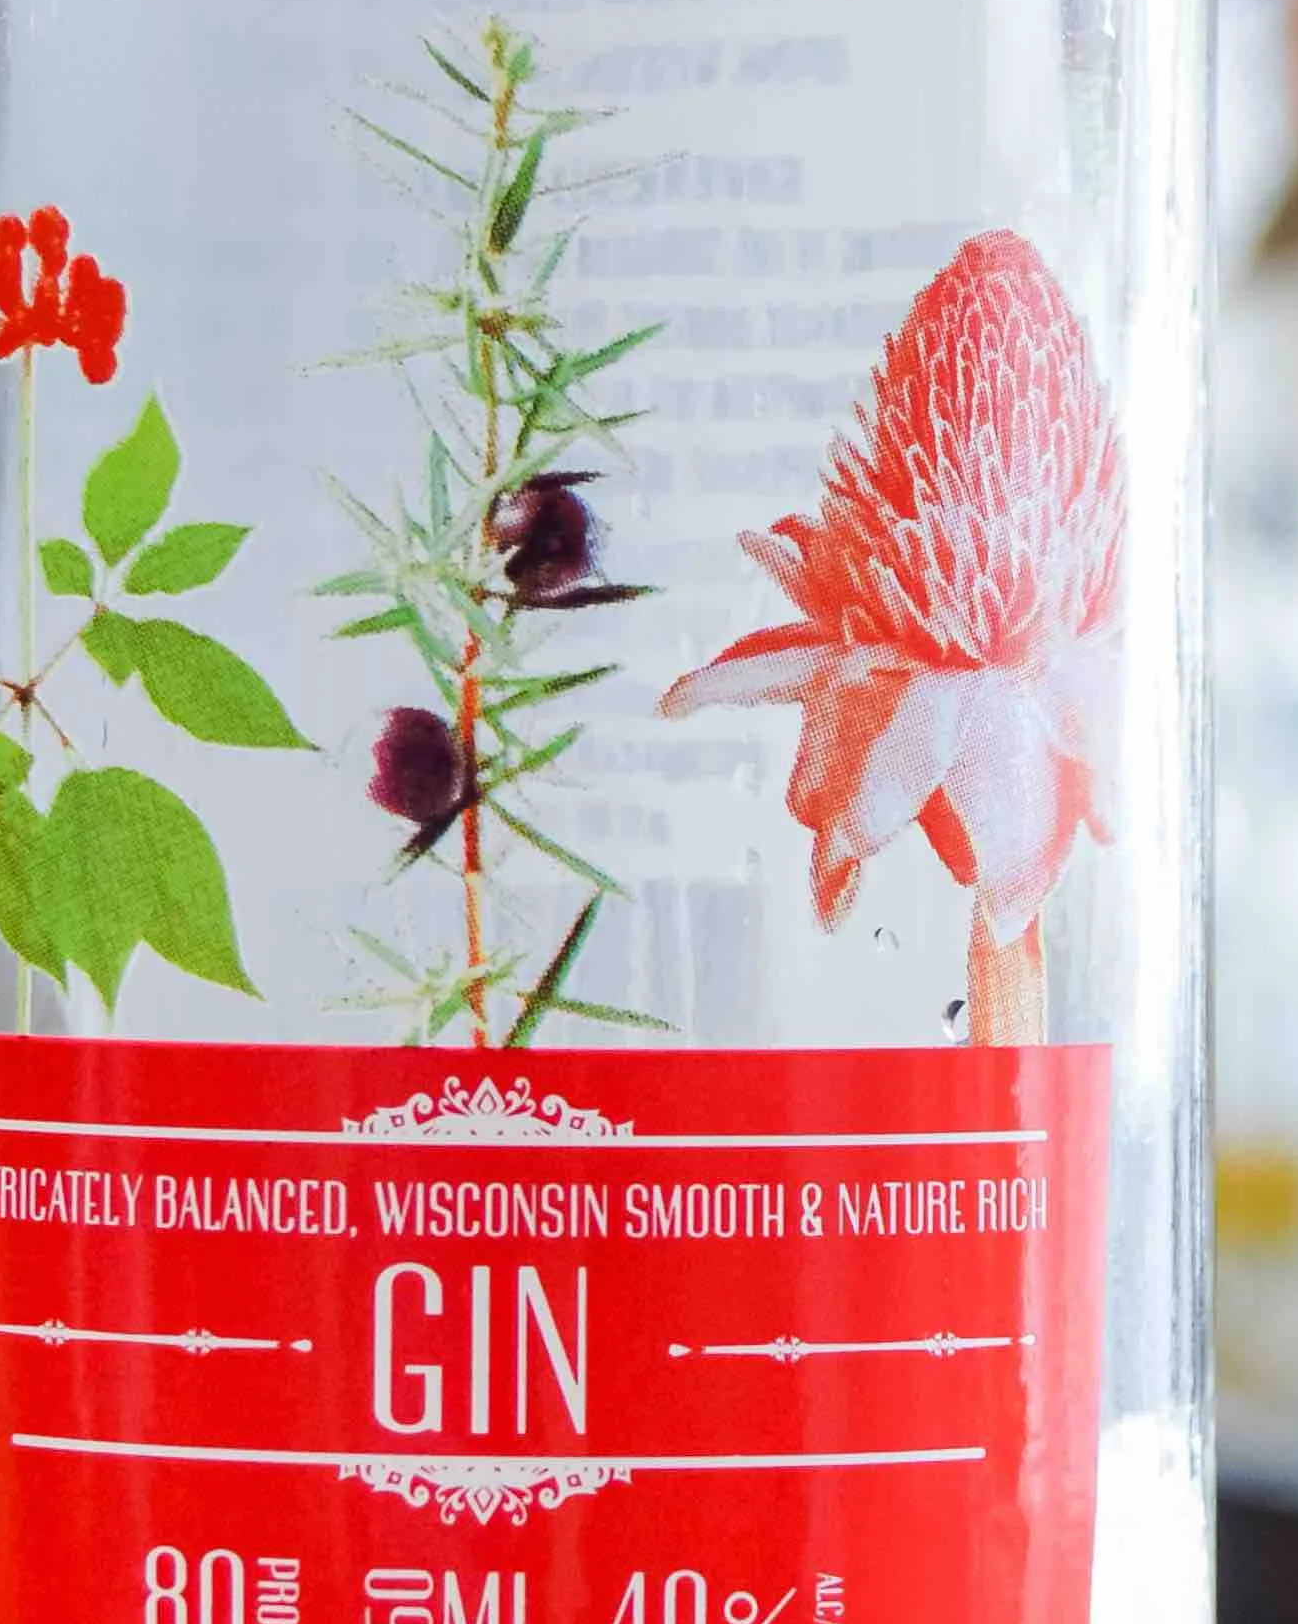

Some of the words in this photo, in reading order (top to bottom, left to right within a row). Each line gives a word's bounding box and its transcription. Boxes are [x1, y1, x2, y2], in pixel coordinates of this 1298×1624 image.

[155, 1173, 359, 1240] BALANCED,
[373, 1180, 609, 1239] WISCONSIN
[624, 1182, 785, 1239] SMOOTH
[800, 1181, 824, 1237] &
[837, 1179, 966, 1237] NATURE
[976, 1176, 1049, 1235] RICH
[373, 1260, 588, 1436] GIN
